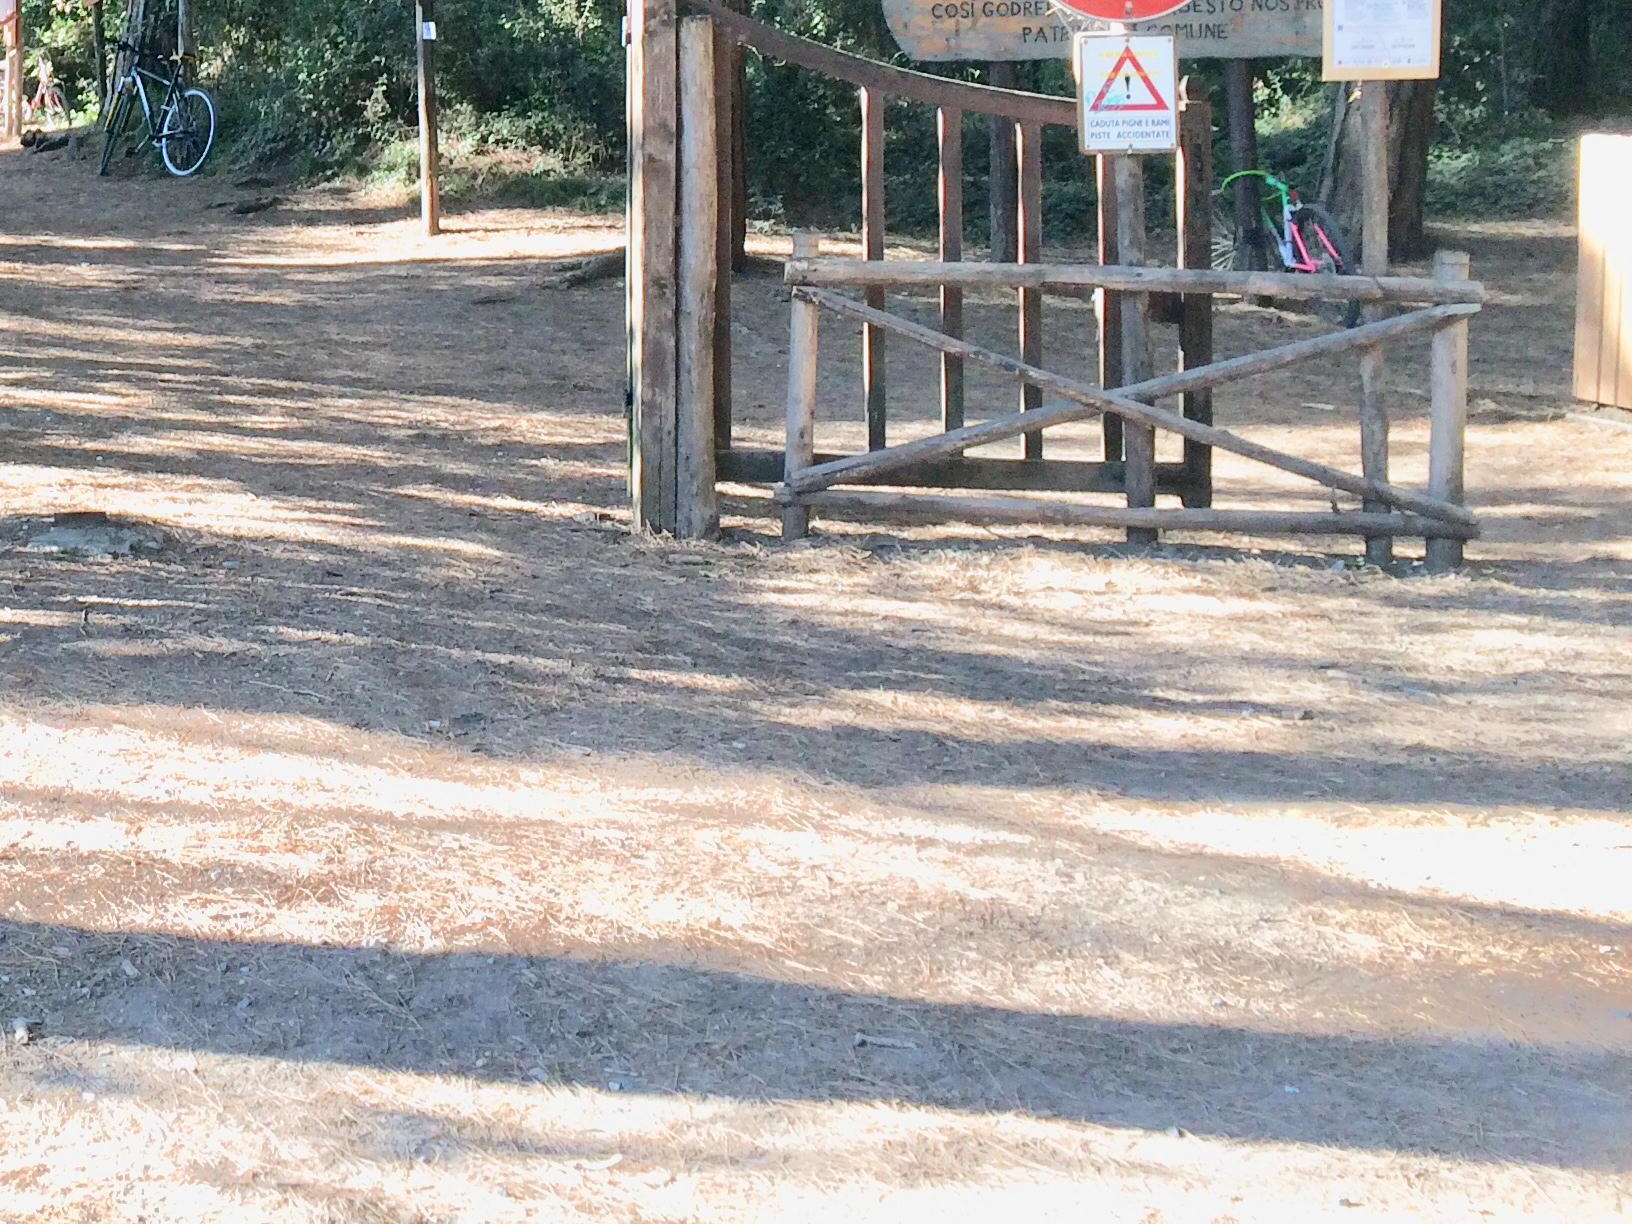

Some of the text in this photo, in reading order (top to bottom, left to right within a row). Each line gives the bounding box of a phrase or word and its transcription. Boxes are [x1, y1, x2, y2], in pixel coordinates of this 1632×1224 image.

[1090, 119, 1120, 128] CADUTA
[1121, 119, 1143, 128] PIGNE
[1151, 118, 1170, 127] RAMI
[1090, 130, 1170, 140] PISTE ACCIDENTATE
